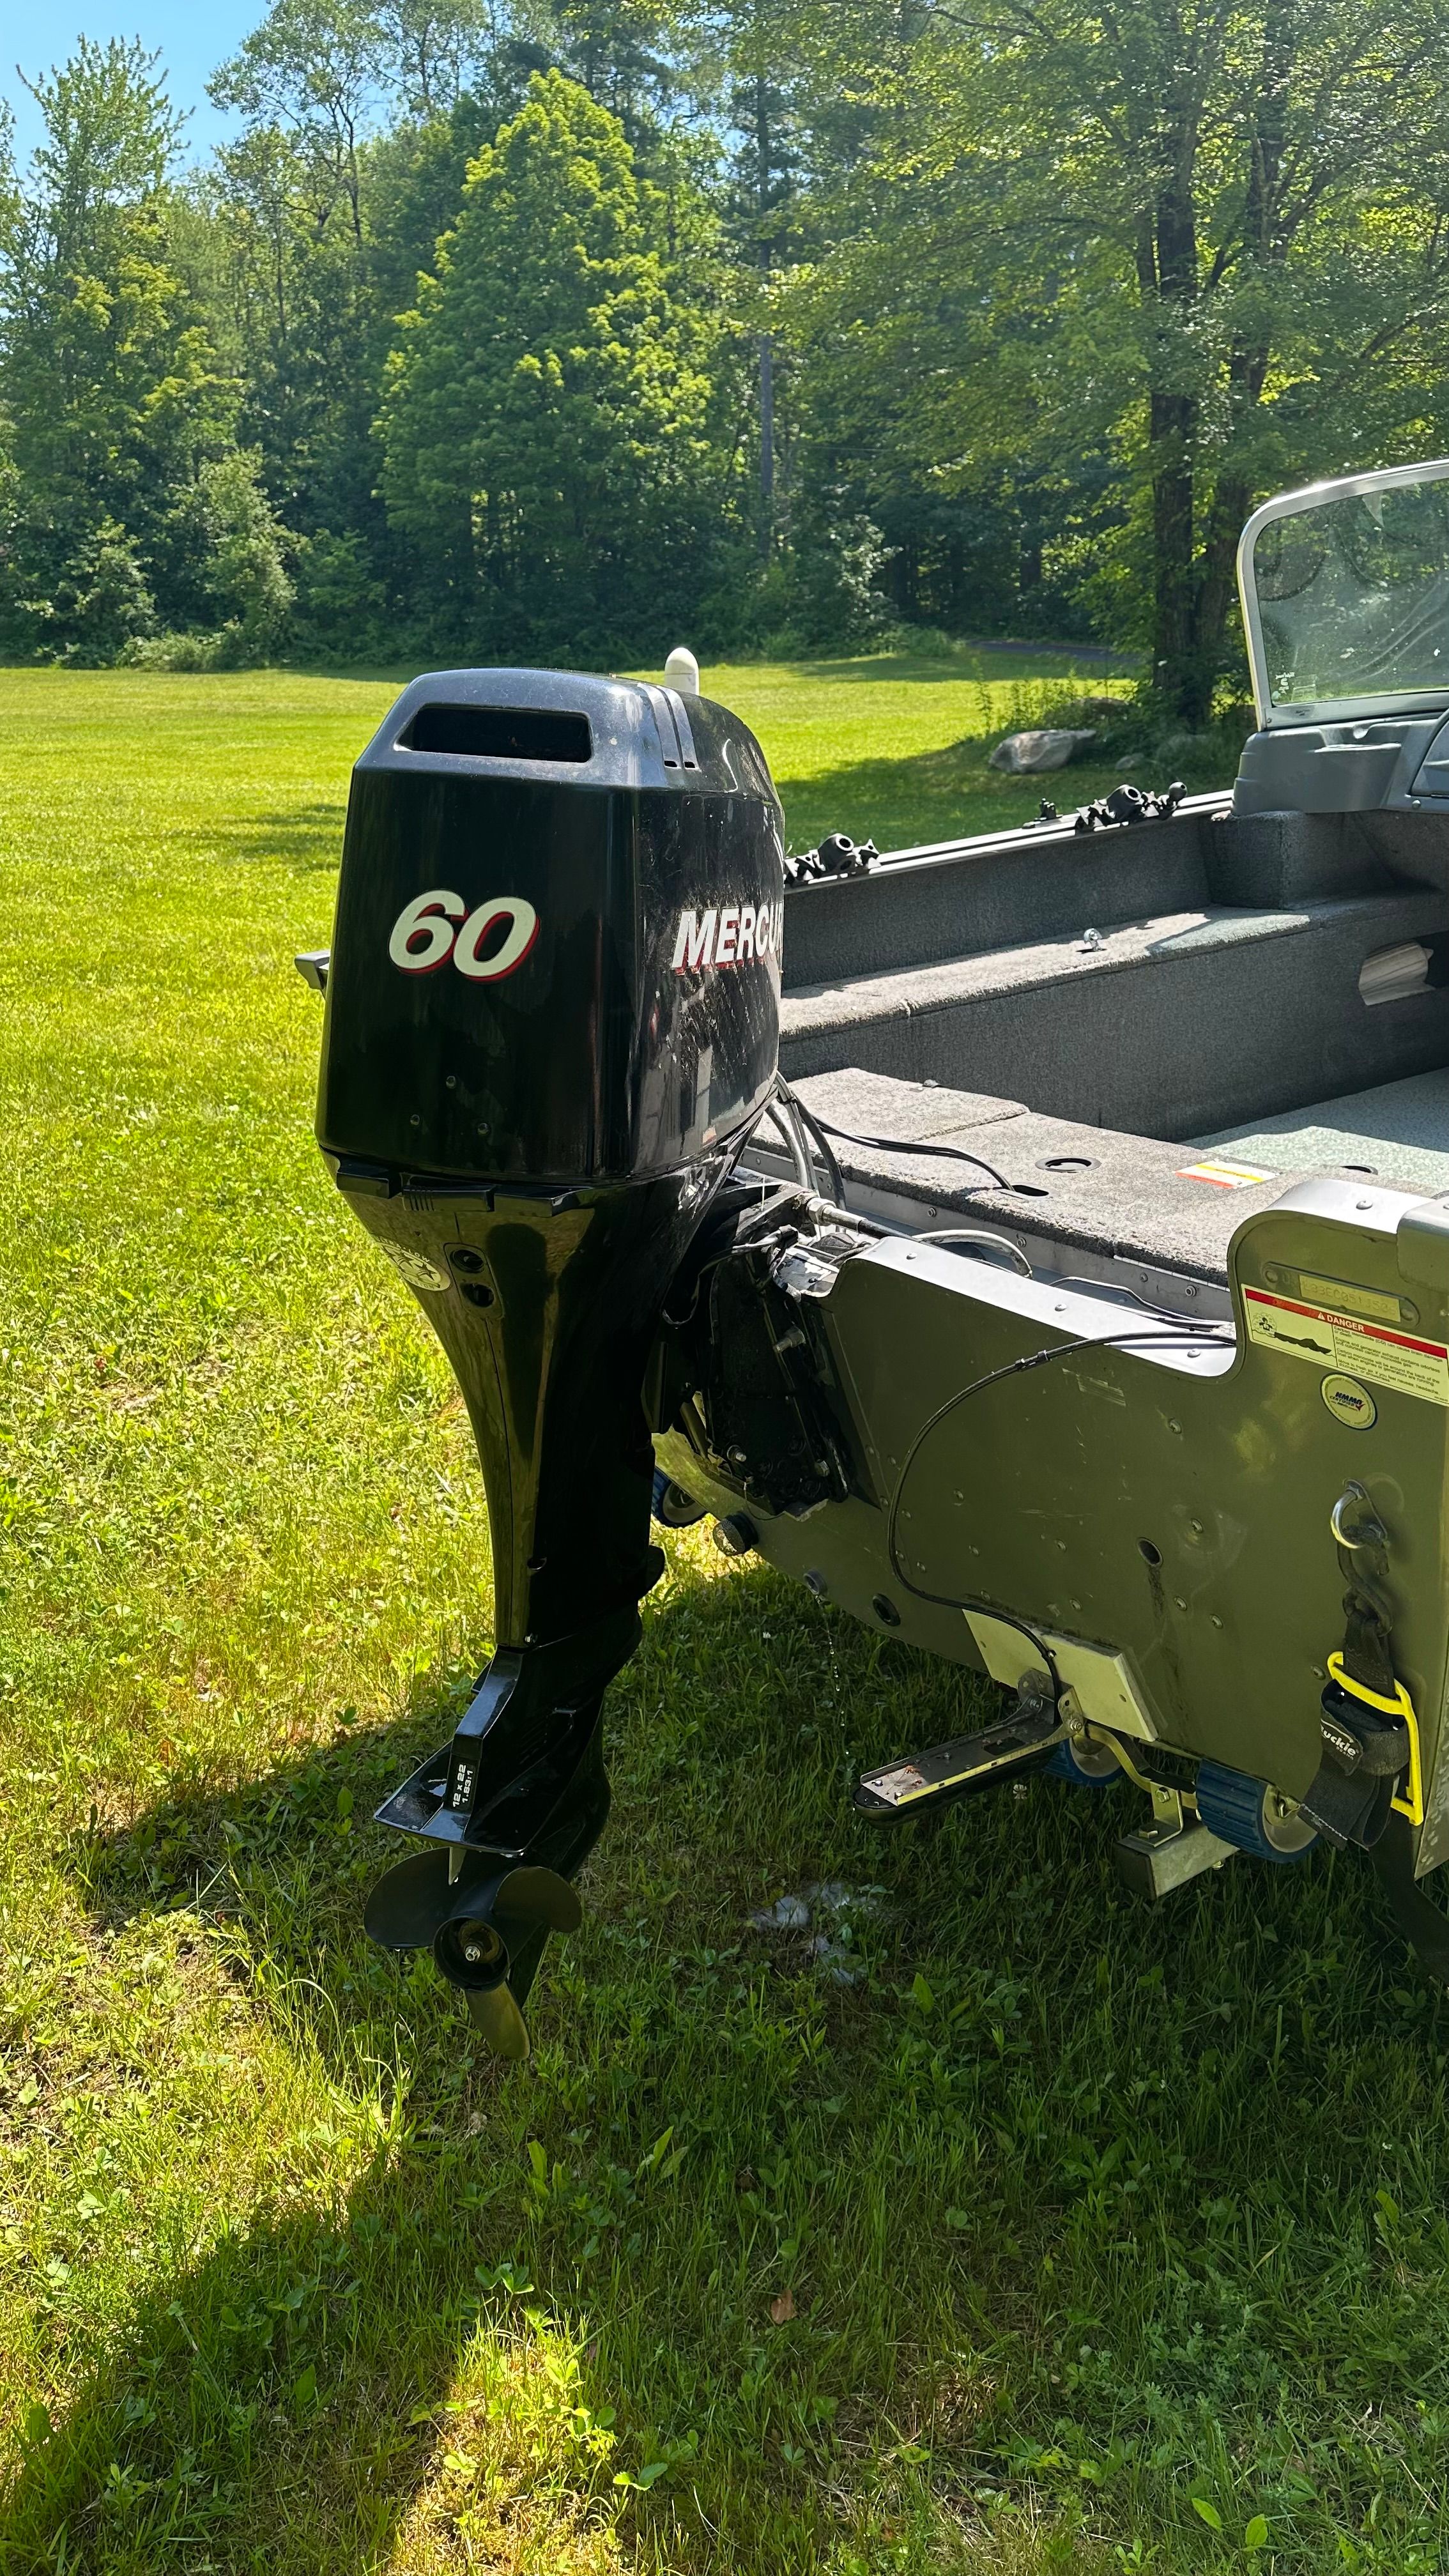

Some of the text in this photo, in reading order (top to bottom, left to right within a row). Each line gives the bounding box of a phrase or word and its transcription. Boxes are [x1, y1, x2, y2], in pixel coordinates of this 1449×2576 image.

[389, 889, 540, 983] 60
[671, 900, 785, 976] MERCUR
[1327, 1315, 1365, 1333] DANGER
[452, 1793, 461, 1807] 12
[457, 1764, 466, 1782] 22
[462, 1770, 473, 1804] 1.83:1
